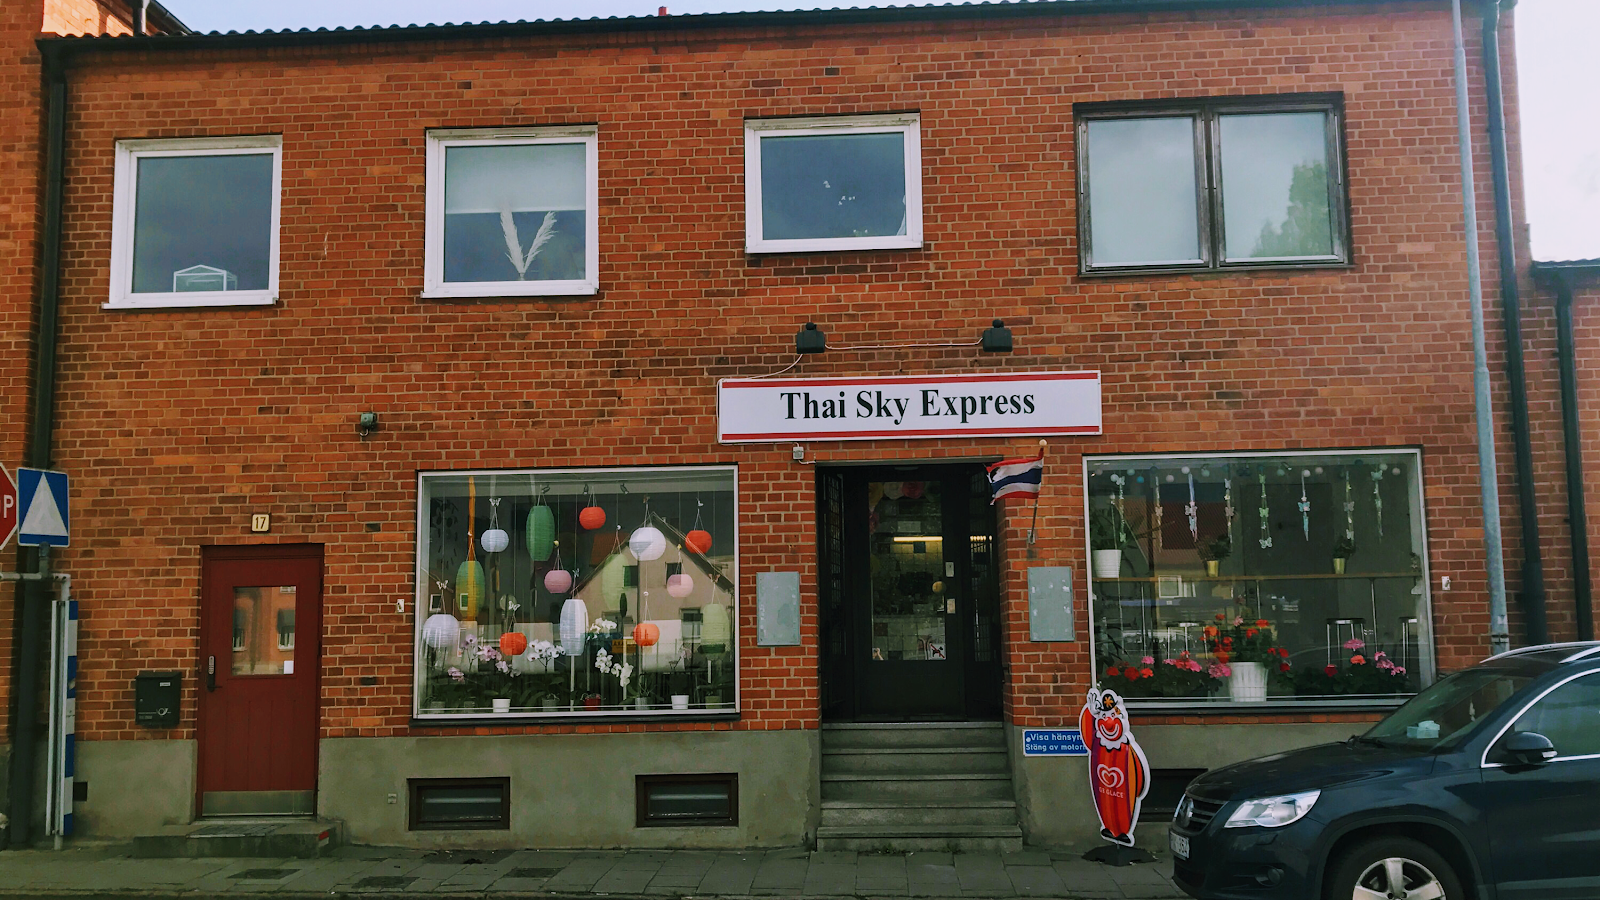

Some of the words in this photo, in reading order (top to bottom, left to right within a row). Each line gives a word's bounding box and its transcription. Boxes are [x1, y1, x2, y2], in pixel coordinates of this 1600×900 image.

[780, 391, 847, 420] Thai
[856, 390, 910, 426] Sky
[919, 389, 1036, 424] Express
[0, 494, 14, 519] P
[255, 516, 266, 530] 17
[1030, 733, 1049, 741] Visa
[1025, 743, 1047, 752] Stäng
[1105, 789, 1124, 799] GLACE
